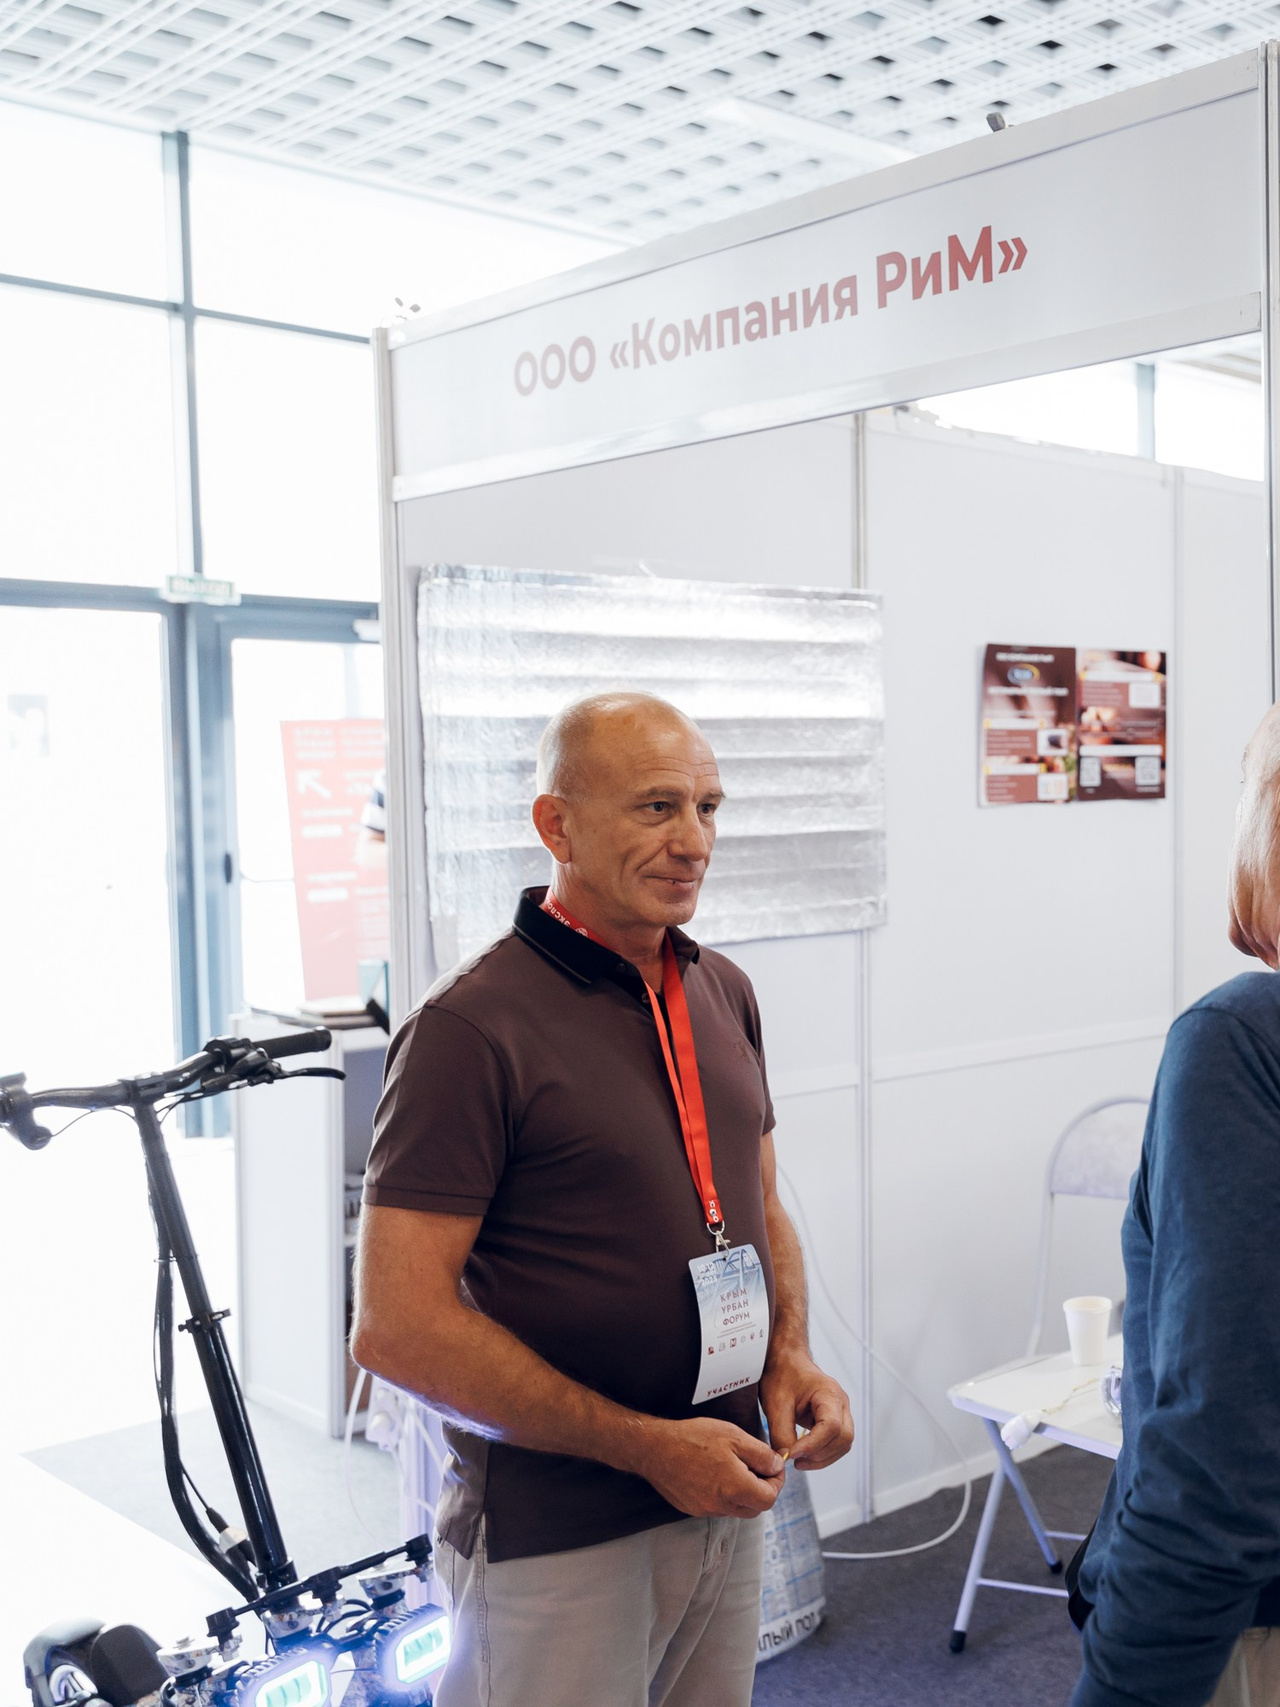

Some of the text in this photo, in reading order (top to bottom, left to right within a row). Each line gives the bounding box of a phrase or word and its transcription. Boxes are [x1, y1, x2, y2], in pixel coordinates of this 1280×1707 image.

[513, 224, 1028, 397] ООО «Компания РиМ»
[720, 1288, 747, 1303] КРЫМ
[721, 1299, 749, 1315] УРБАН
[722, 1311, 751, 1326] ФОРУМ
[707, 1377, 750, 1397] УЧАСТНИК
